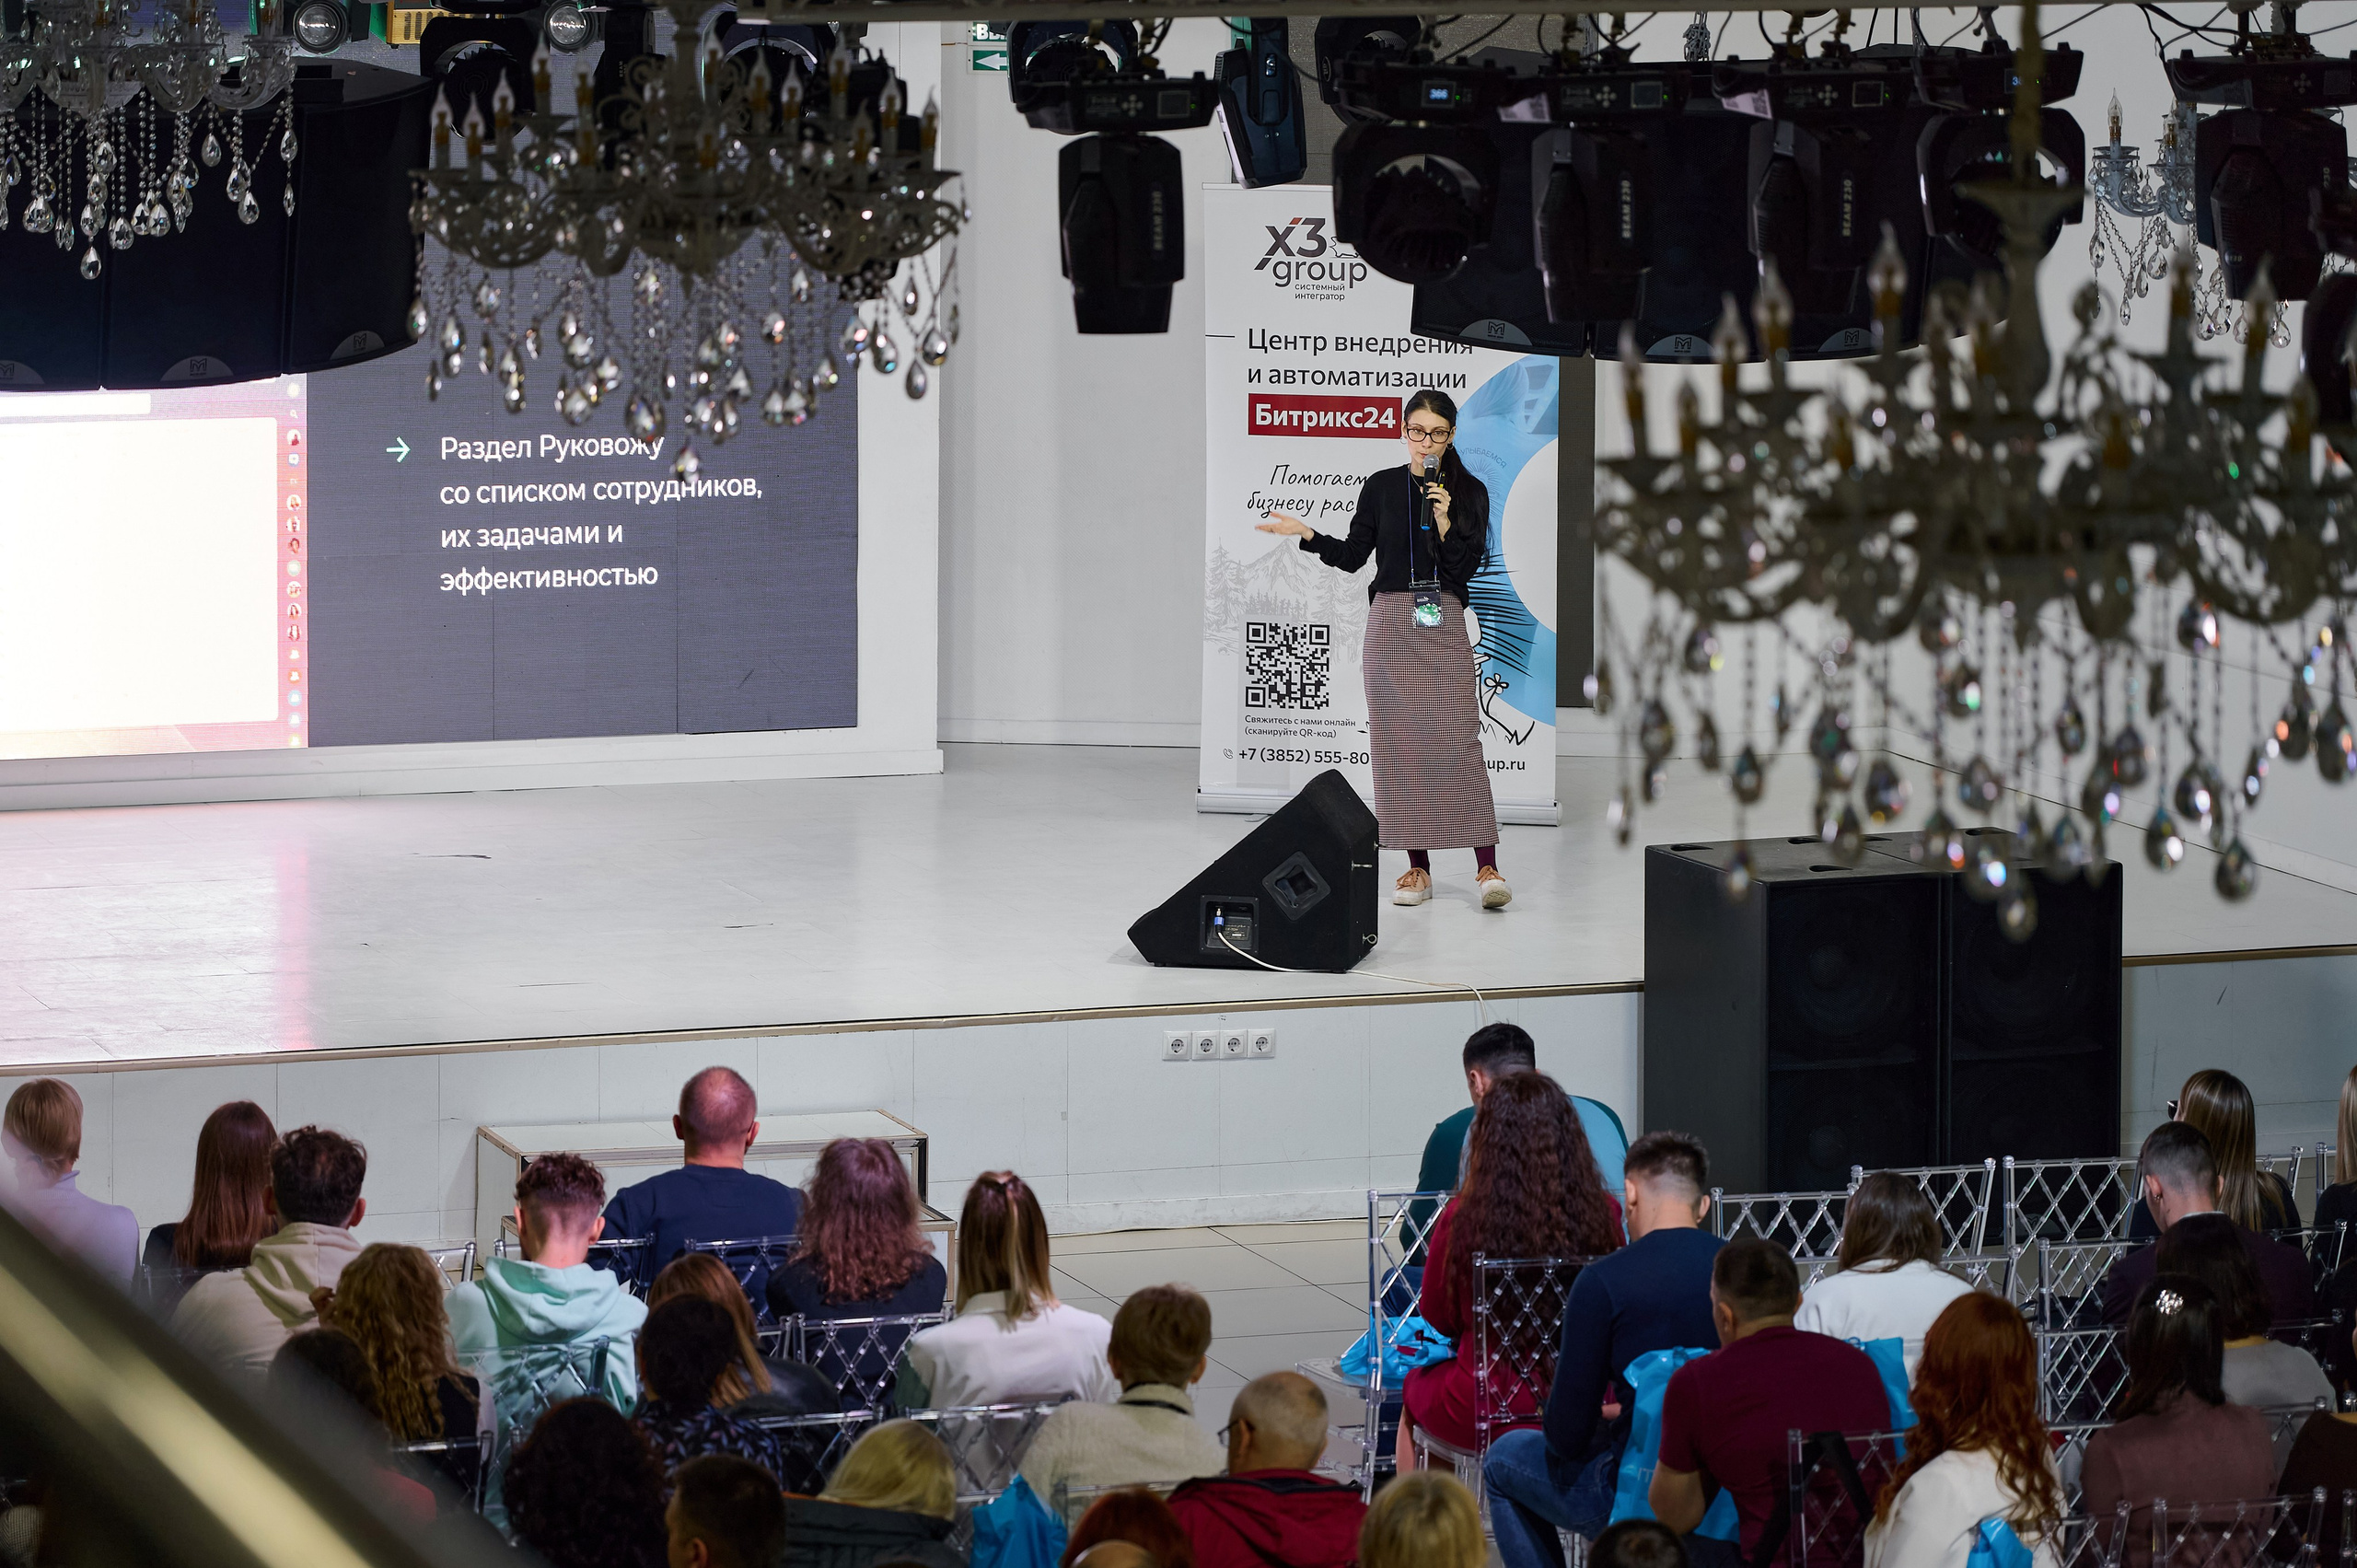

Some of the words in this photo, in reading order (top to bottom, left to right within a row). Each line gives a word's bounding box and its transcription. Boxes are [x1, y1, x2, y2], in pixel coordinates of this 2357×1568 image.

[1843, 179, 1852, 202] 230
[1272, 261, 1368, 289] group
[1295, 283, 1345, 292] системный
[1295, 292, 1345, 302] интегратор
[1248, 328, 1328, 356] Центр
[1334, 335, 1473, 358] внедрения
[1248, 368, 1262, 384] и
[1268, 369, 1467, 390] автоматизации
[1255, 402, 1397, 432] Битрикс24
[440, 436, 532, 462] Раздел
[539, 434, 666, 463] Руковожу
[1270, 464, 1367, 486] Помогаем
[439, 485, 470, 505] со
[476, 482, 586, 504] списком
[593, 477, 763, 505] сотрудников,
[1247, 491, 1315, 519] бизнесу
[1319, 498, 1355, 518] рас
[441, 528, 471, 549] их
[476, 526, 599, 551] задачами
[607, 524, 623, 543] и
[439, 566, 659, 596] эффективностью
[1245, 714, 1292, 725] Свяжитесь
[1324, 718, 1356, 726] онлайн
[1245, 726, 1298, 737] (сканируйте
[1299, 728, 1337, 738] QR-код)
[1238, 748, 1257, 761] +7
[1260, 747, 1311, 764] (3852)
[1314, 750, 1370, 765] 555-80
[1487, 760, 1526, 772] up.ru
